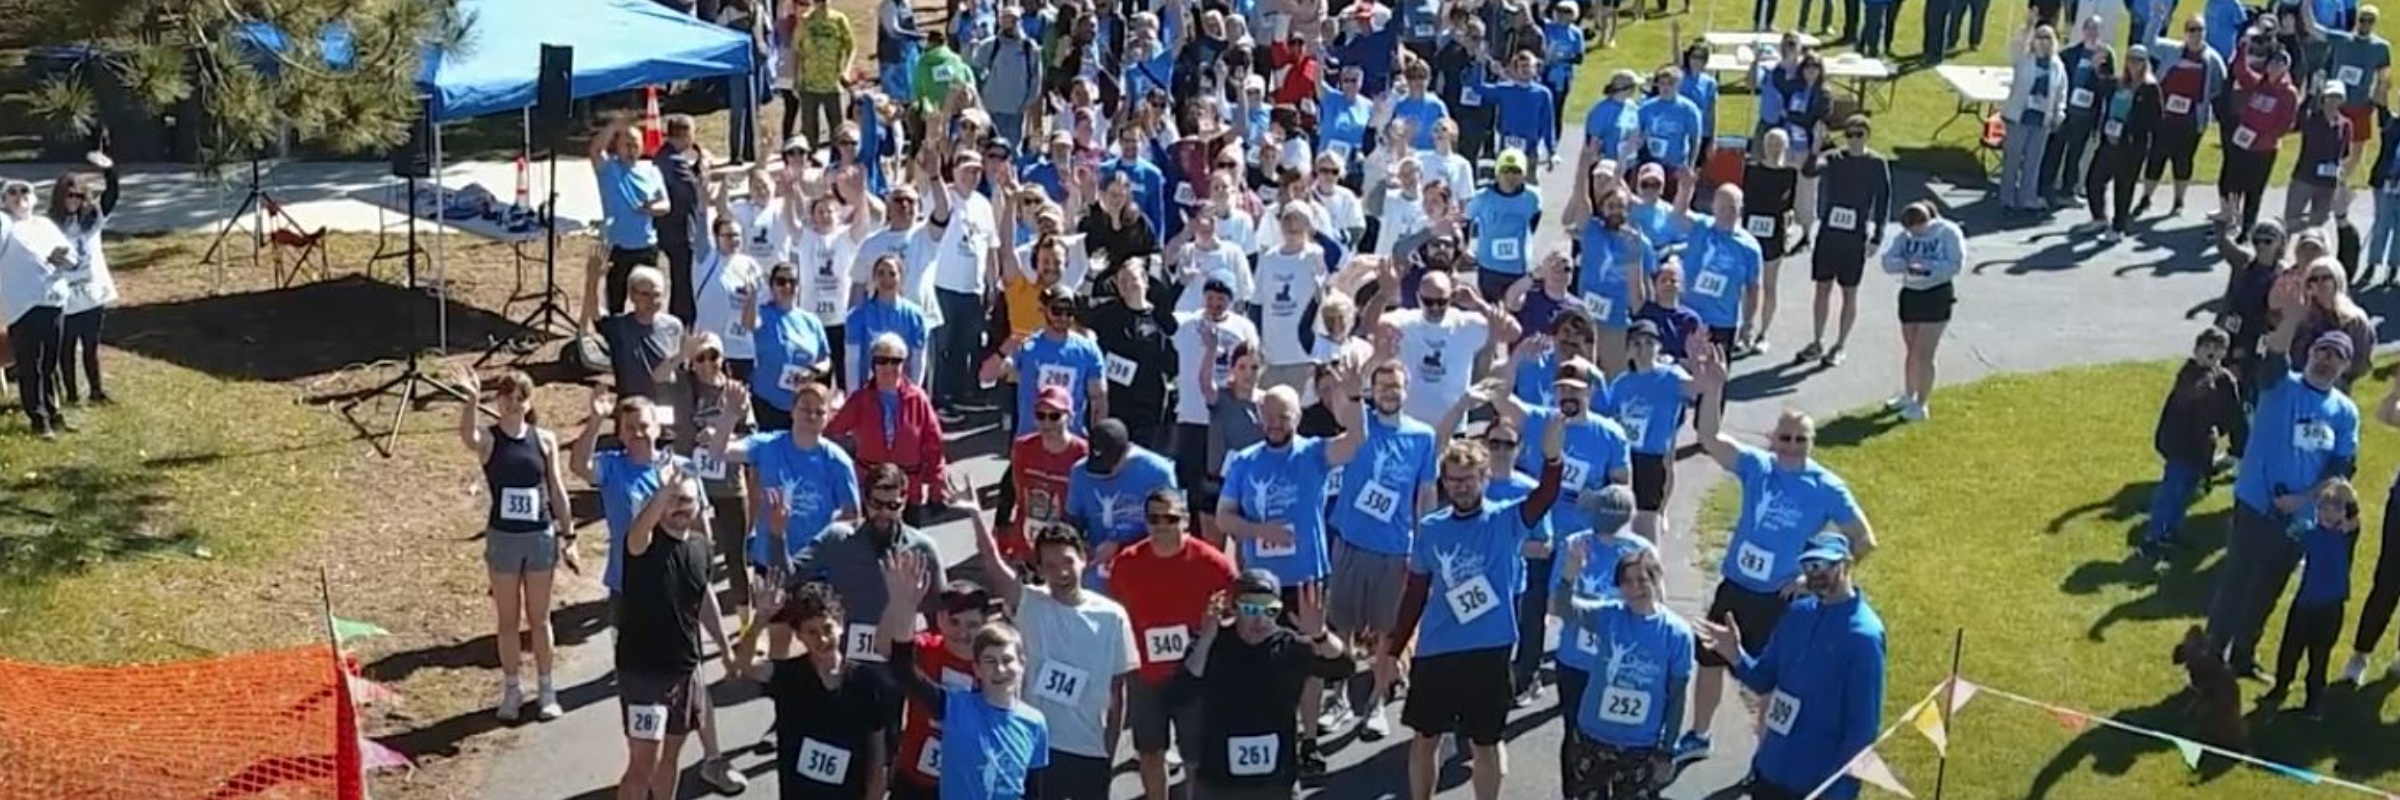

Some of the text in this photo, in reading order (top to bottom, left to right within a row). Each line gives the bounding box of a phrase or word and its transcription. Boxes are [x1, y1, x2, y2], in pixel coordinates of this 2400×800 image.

[1904, 238, 1940, 256] UW
[508, 494, 532, 515] 333
[1363, 488, 1392, 514] 330
[1741, 549, 1766, 572] 283
[1456, 585, 1488, 614] 326
[857, 632, 878, 655] 31
[1151, 632, 1183, 655] 340
[1044, 669, 1077, 698] 314
[1607, 694, 1643, 718] 252
[806, 749, 839, 776] 316
[1237, 744, 1270, 767] 261
